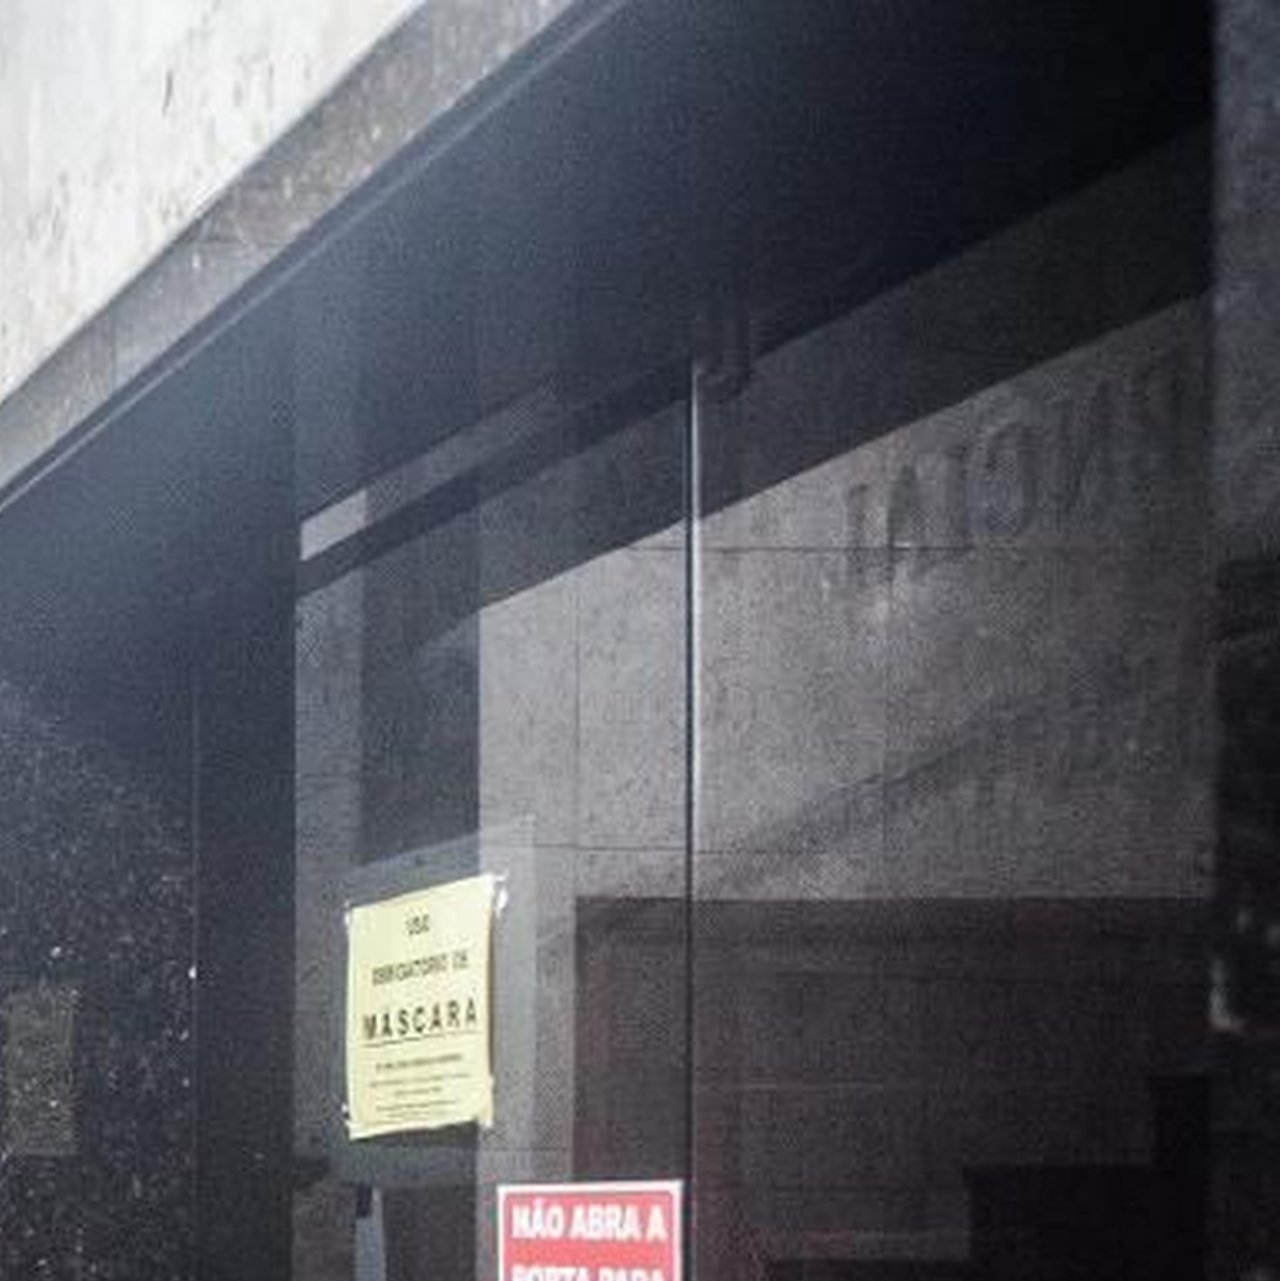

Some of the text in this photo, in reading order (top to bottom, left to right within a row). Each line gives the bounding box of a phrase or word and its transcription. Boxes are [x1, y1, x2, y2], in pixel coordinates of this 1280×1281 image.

[510, 1197, 669, 1243] NÃO ABRA A
